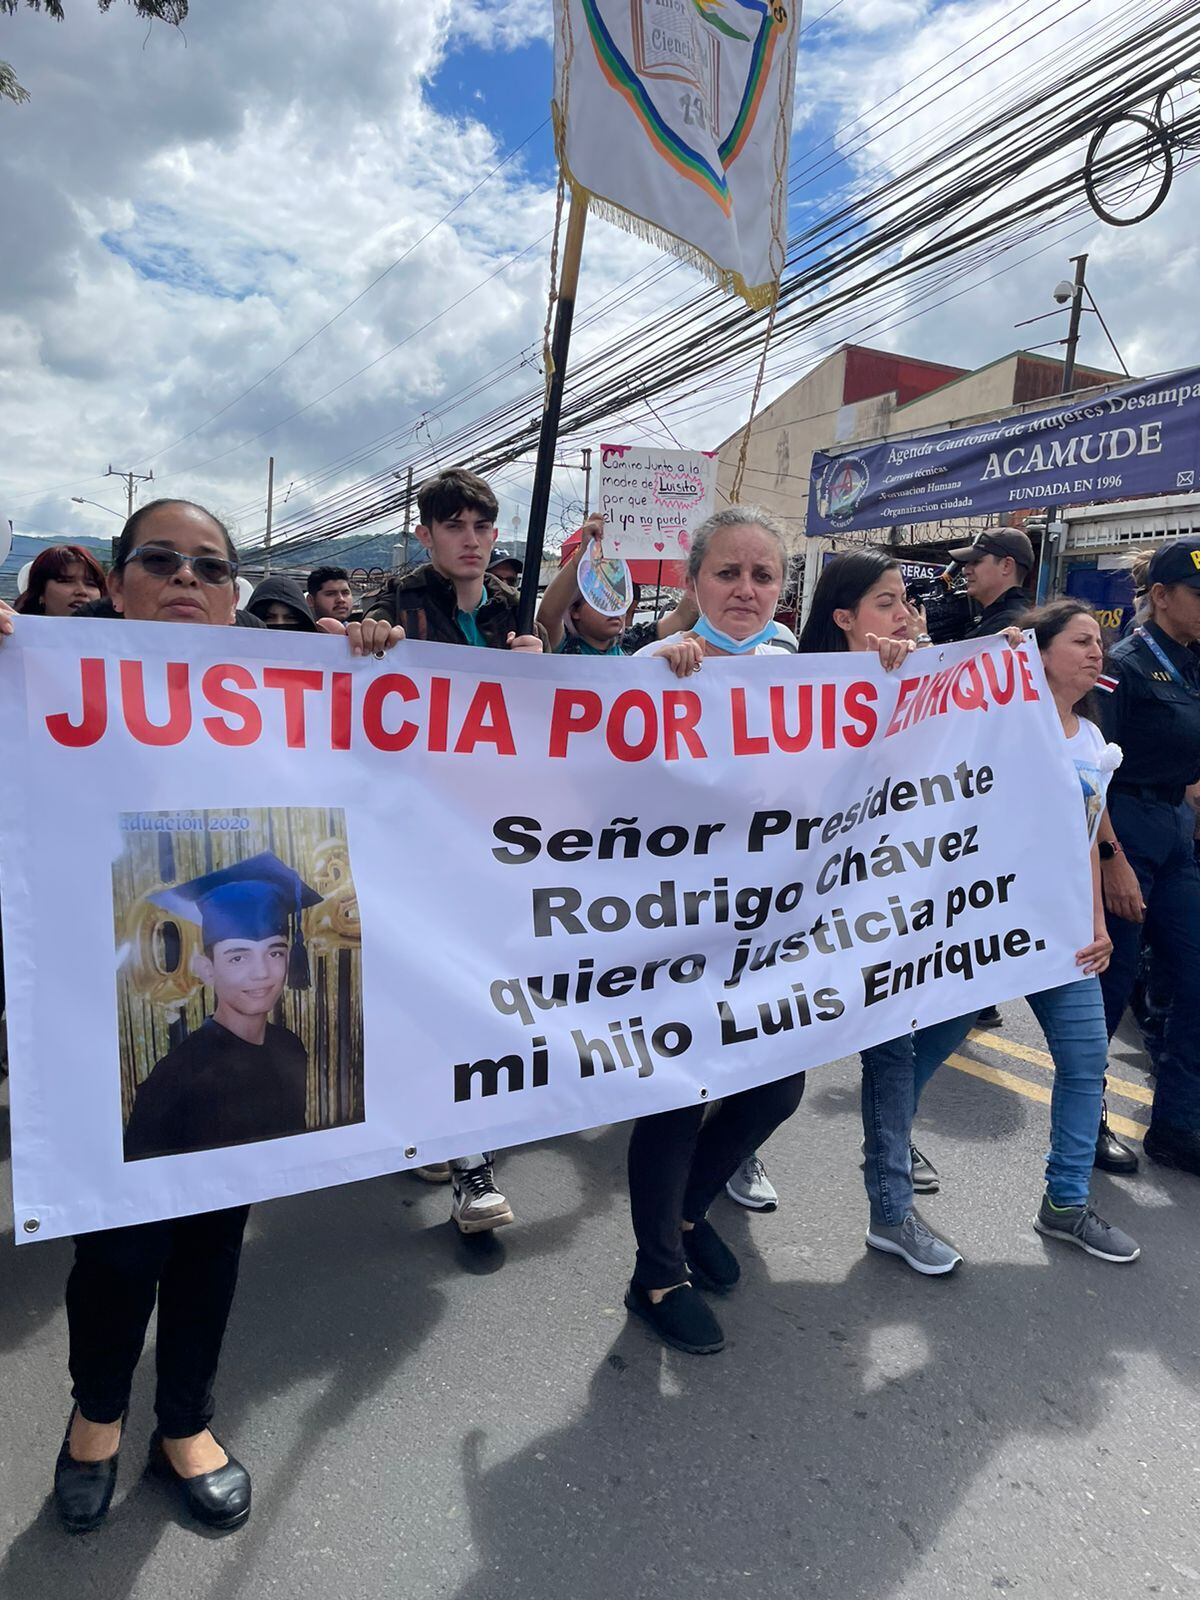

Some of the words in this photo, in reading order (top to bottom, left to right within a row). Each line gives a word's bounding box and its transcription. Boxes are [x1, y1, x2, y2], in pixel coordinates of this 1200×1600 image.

[887, 443, 932, 465] Agenda
[1005, 423, 1025, 437] de
[1027, 405, 1104, 432] Mujeres
[980, 421, 1163, 481] ACAMUDE
[602, 474, 638, 488] madre
[642, 477, 653, 489] de
[659, 477, 697, 493] Luisito
[602, 495, 623, 511] por
[628, 496, 647, 509] que
[1009, 482, 1071, 501] FUNDADA
[1074, 480, 1093, 492] EN
[1097, 475, 1122, 489] 1996
[620, 514, 635, 531] ya
[657, 512, 688, 531] puede
[45, 657, 517, 756] JUSTICIA
[548, 688, 708, 762] POR
[732, 681, 878, 756] LUIS
[884, 649, 1039, 738] ENRIQUE
[209, 817, 250, 831] 2020
[491, 815, 727, 865] Señor
[747, 760, 994, 853] Presidente
[532, 877, 804, 938] Rodrigo
[816, 825, 979, 895] Chávez
[489, 953, 707, 1026] quiero
[724, 895, 934, 989] justicia
[946, 873, 1016, 928] por
[453, 1036, 549, 1103] mi
[576, 1015, 693, 1078] hijo
[717, 981, 846, 1046] Luis
[861, 927, 1047, 1008] Enrique.
